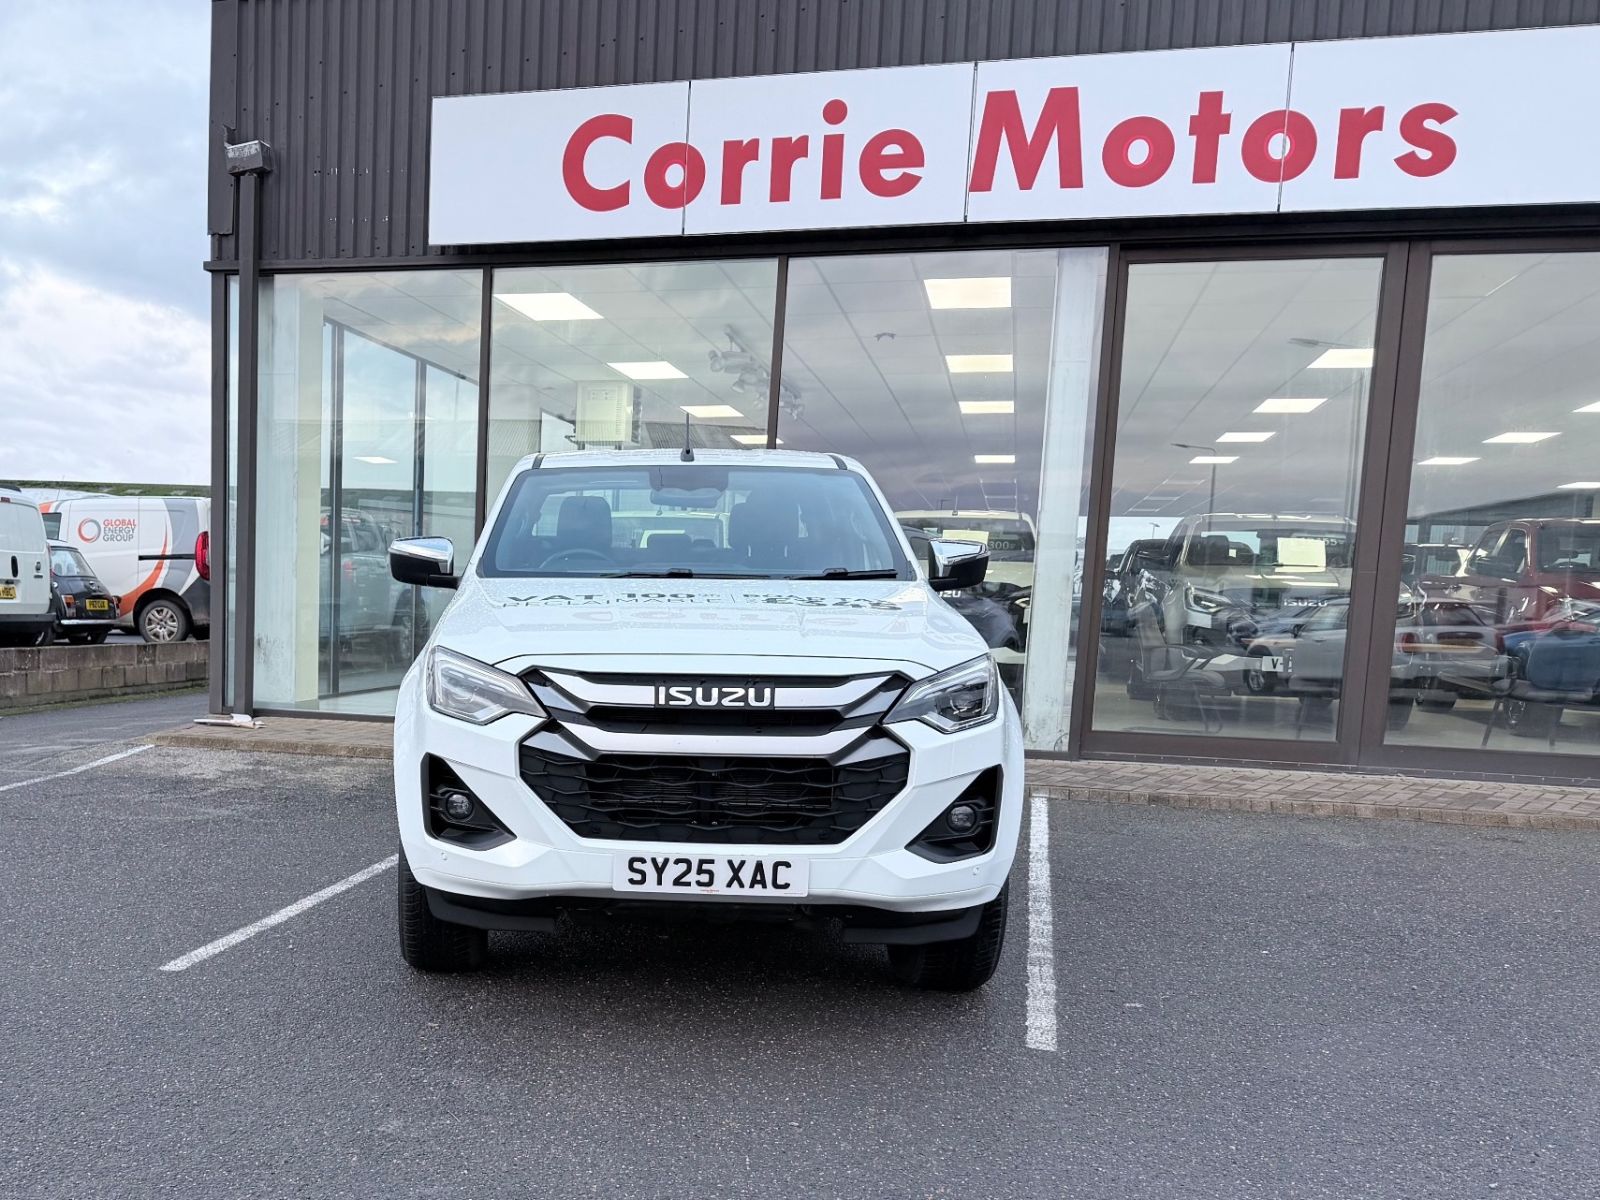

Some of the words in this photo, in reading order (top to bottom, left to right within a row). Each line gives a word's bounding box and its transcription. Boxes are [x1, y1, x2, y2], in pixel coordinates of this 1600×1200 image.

[562, 98, 925, 213] Corrie
[968, 86, 1460, 192] Motors
[102, 518, 137, 527] GLOBAL
[102, 526, 136, 534] ENERGY
[102, 533, 134, 542] GROUP
[506, 594, 604, 602] VAT
[1283, 598, 1328, 607] ISUZU
[502, 598, 722, 608] RECLAIMABLE
[658, 686, 771, 707] ISUZU
[627, 856, 715, 887] SY25
[725, 859, 792, 890] XAC
